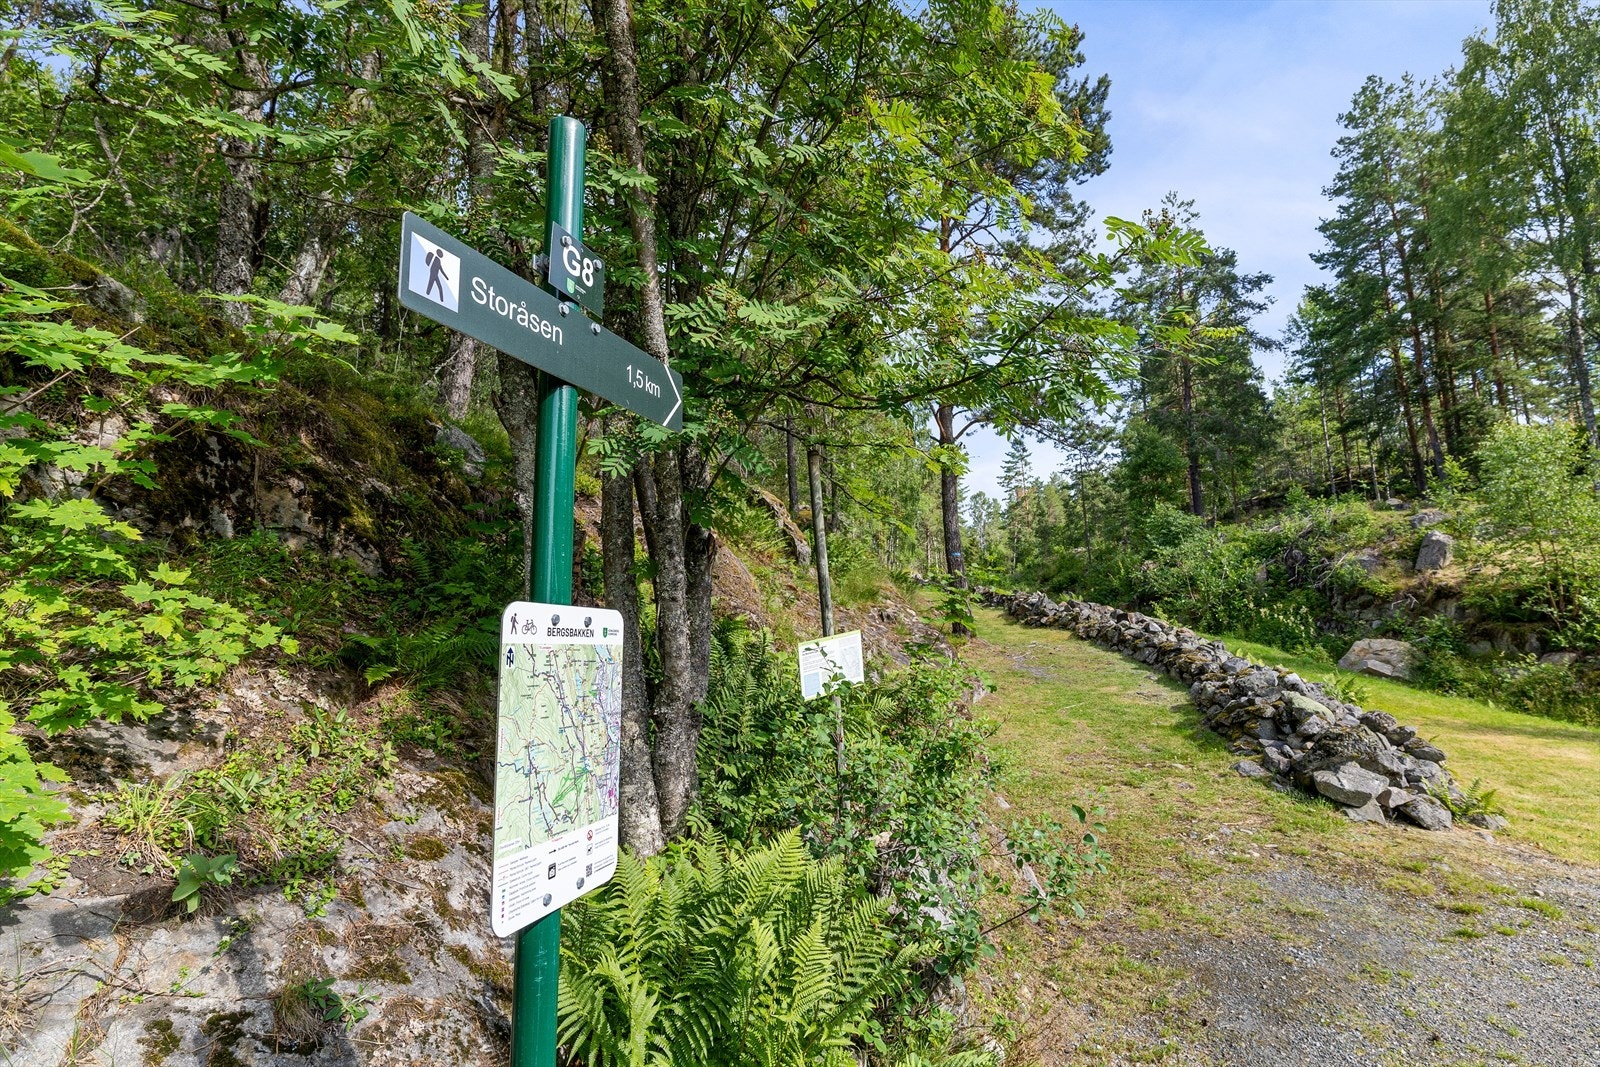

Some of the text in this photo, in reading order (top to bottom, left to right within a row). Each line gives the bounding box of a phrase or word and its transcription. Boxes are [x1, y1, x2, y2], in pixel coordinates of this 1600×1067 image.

[562, 245, 594, 287] G8
[471, 276, 563, 345] Storåsen
[626, 364, 661, 398] 1,5 km
[546, 627, 595, 638] BERGSBAKKEN
